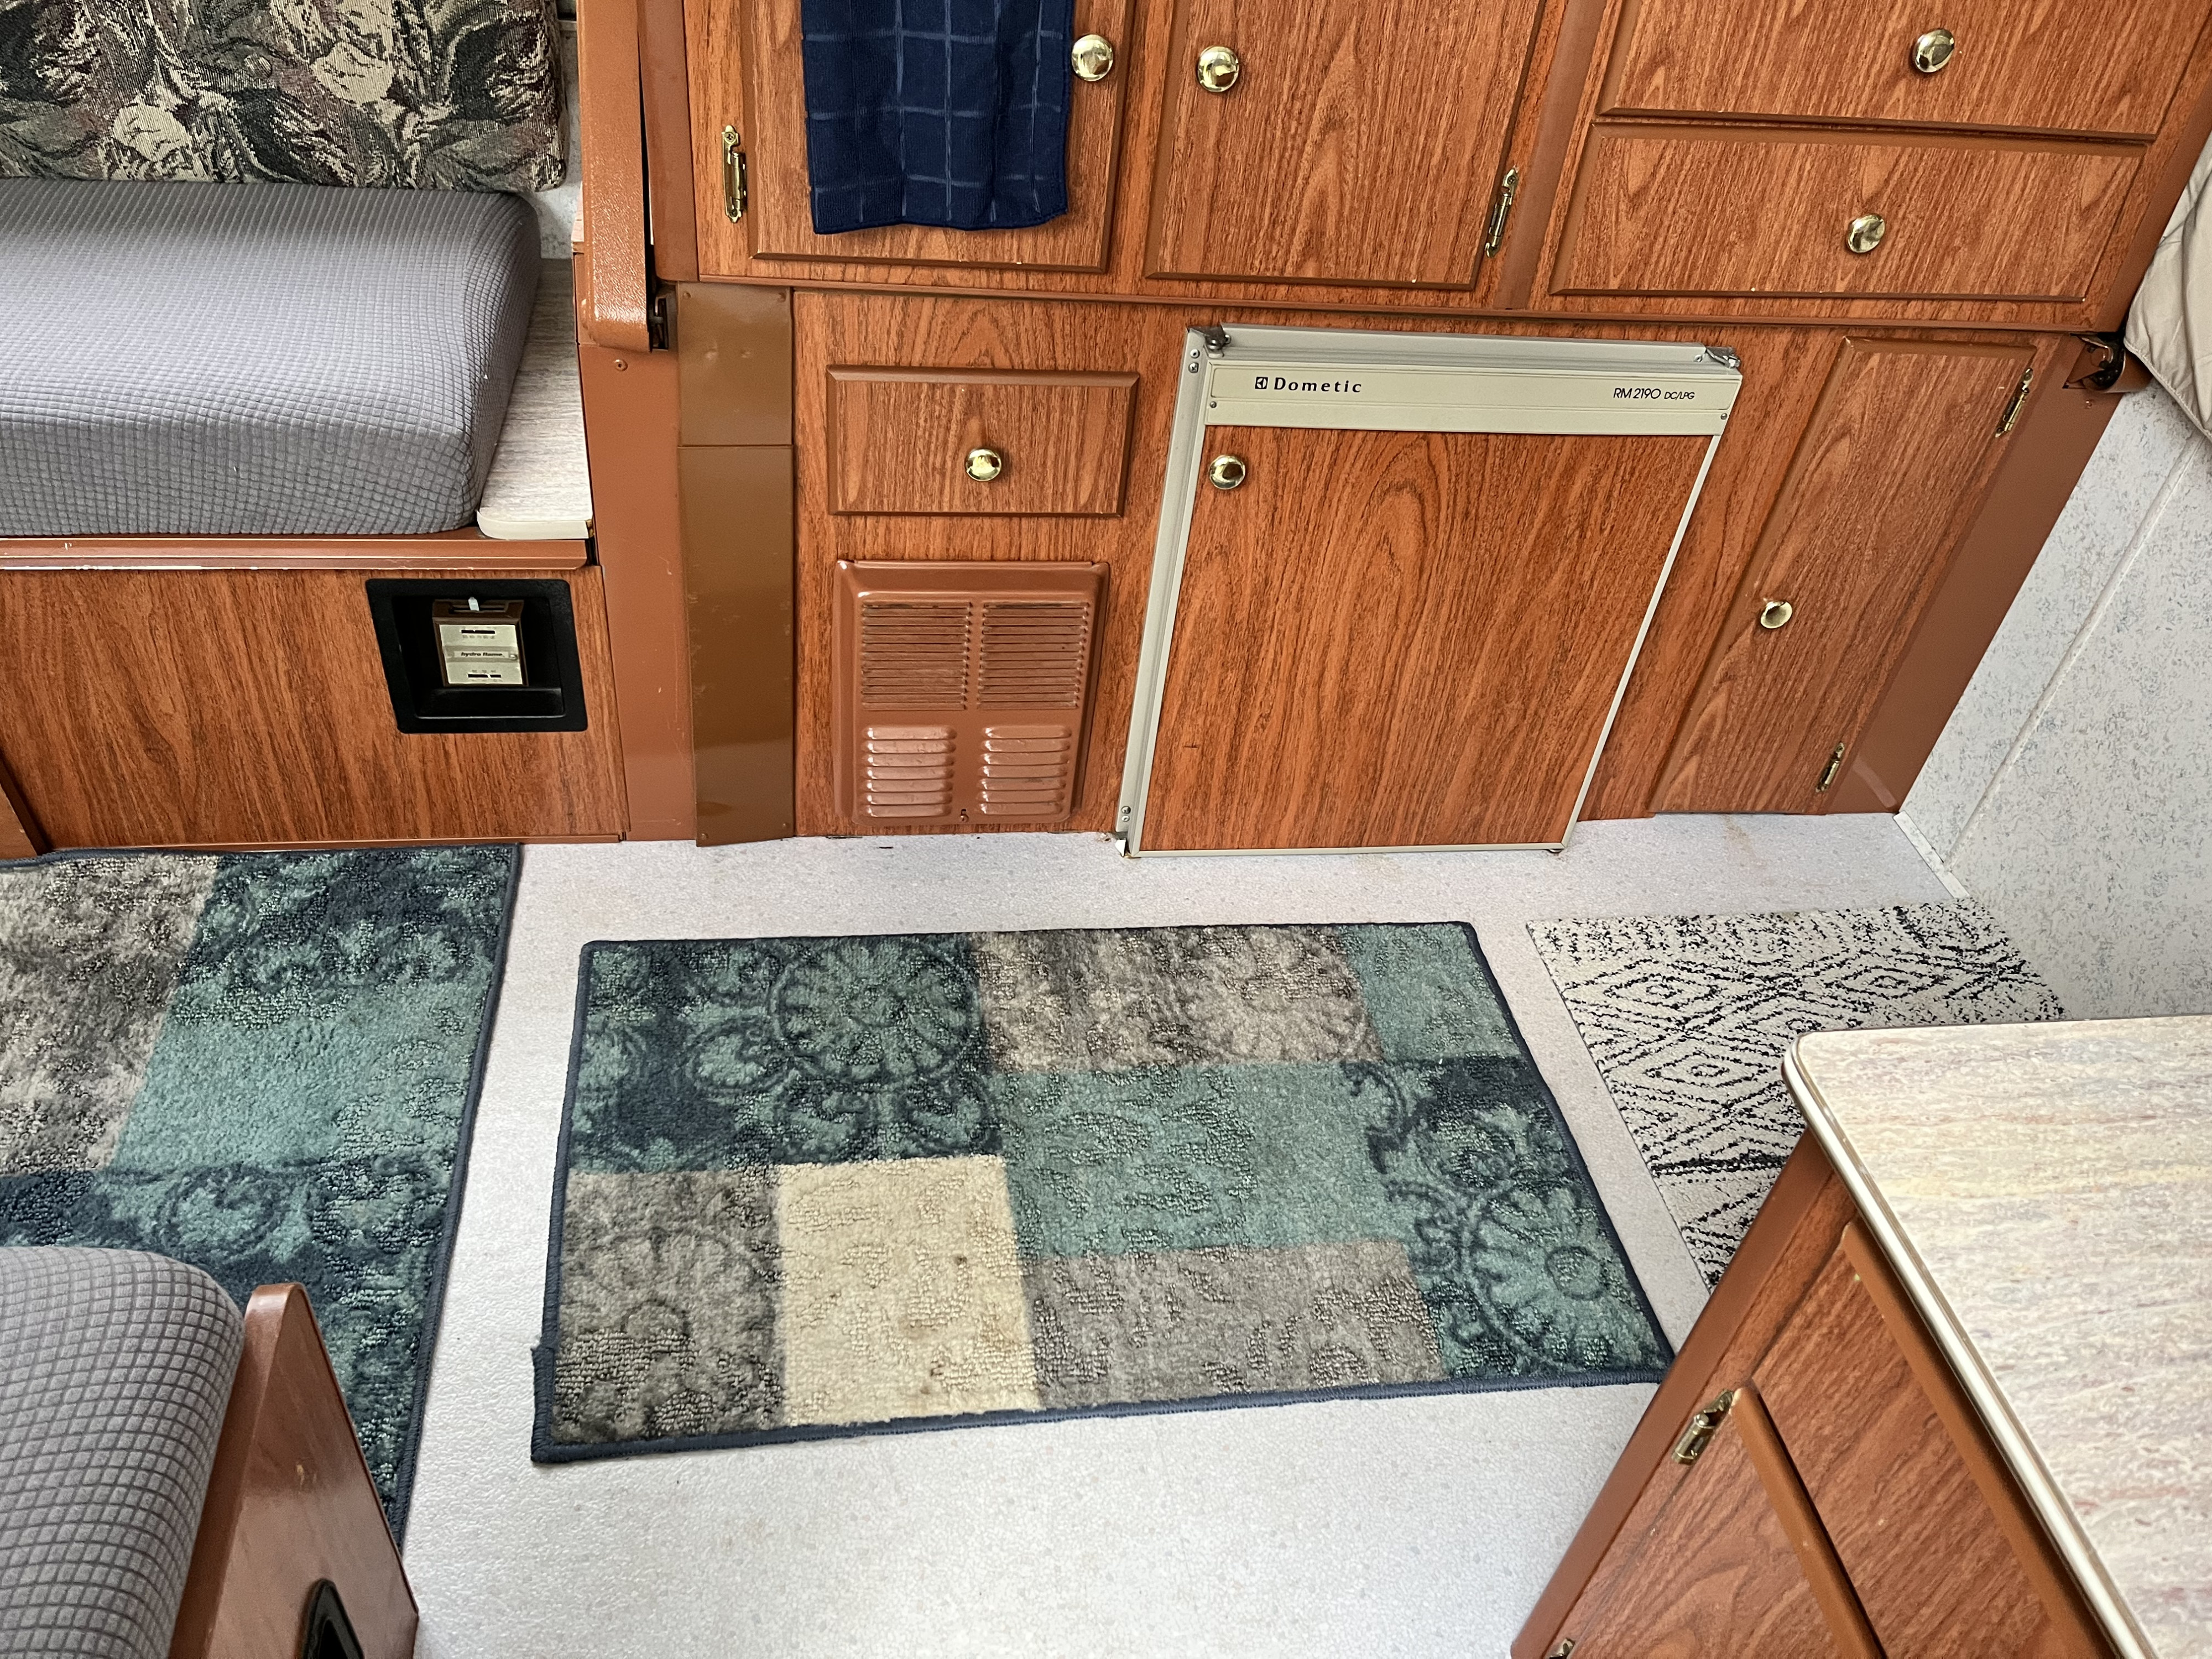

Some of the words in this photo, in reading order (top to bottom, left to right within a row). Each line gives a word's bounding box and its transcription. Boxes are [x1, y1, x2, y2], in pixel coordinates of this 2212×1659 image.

[1274, 377, 1362, 393] Dometic
[1613, 388, 1632, 399] RM
[1633, 388, 1661, 399] 2190
[1664, 392, 1695, 400] DC/LPG
